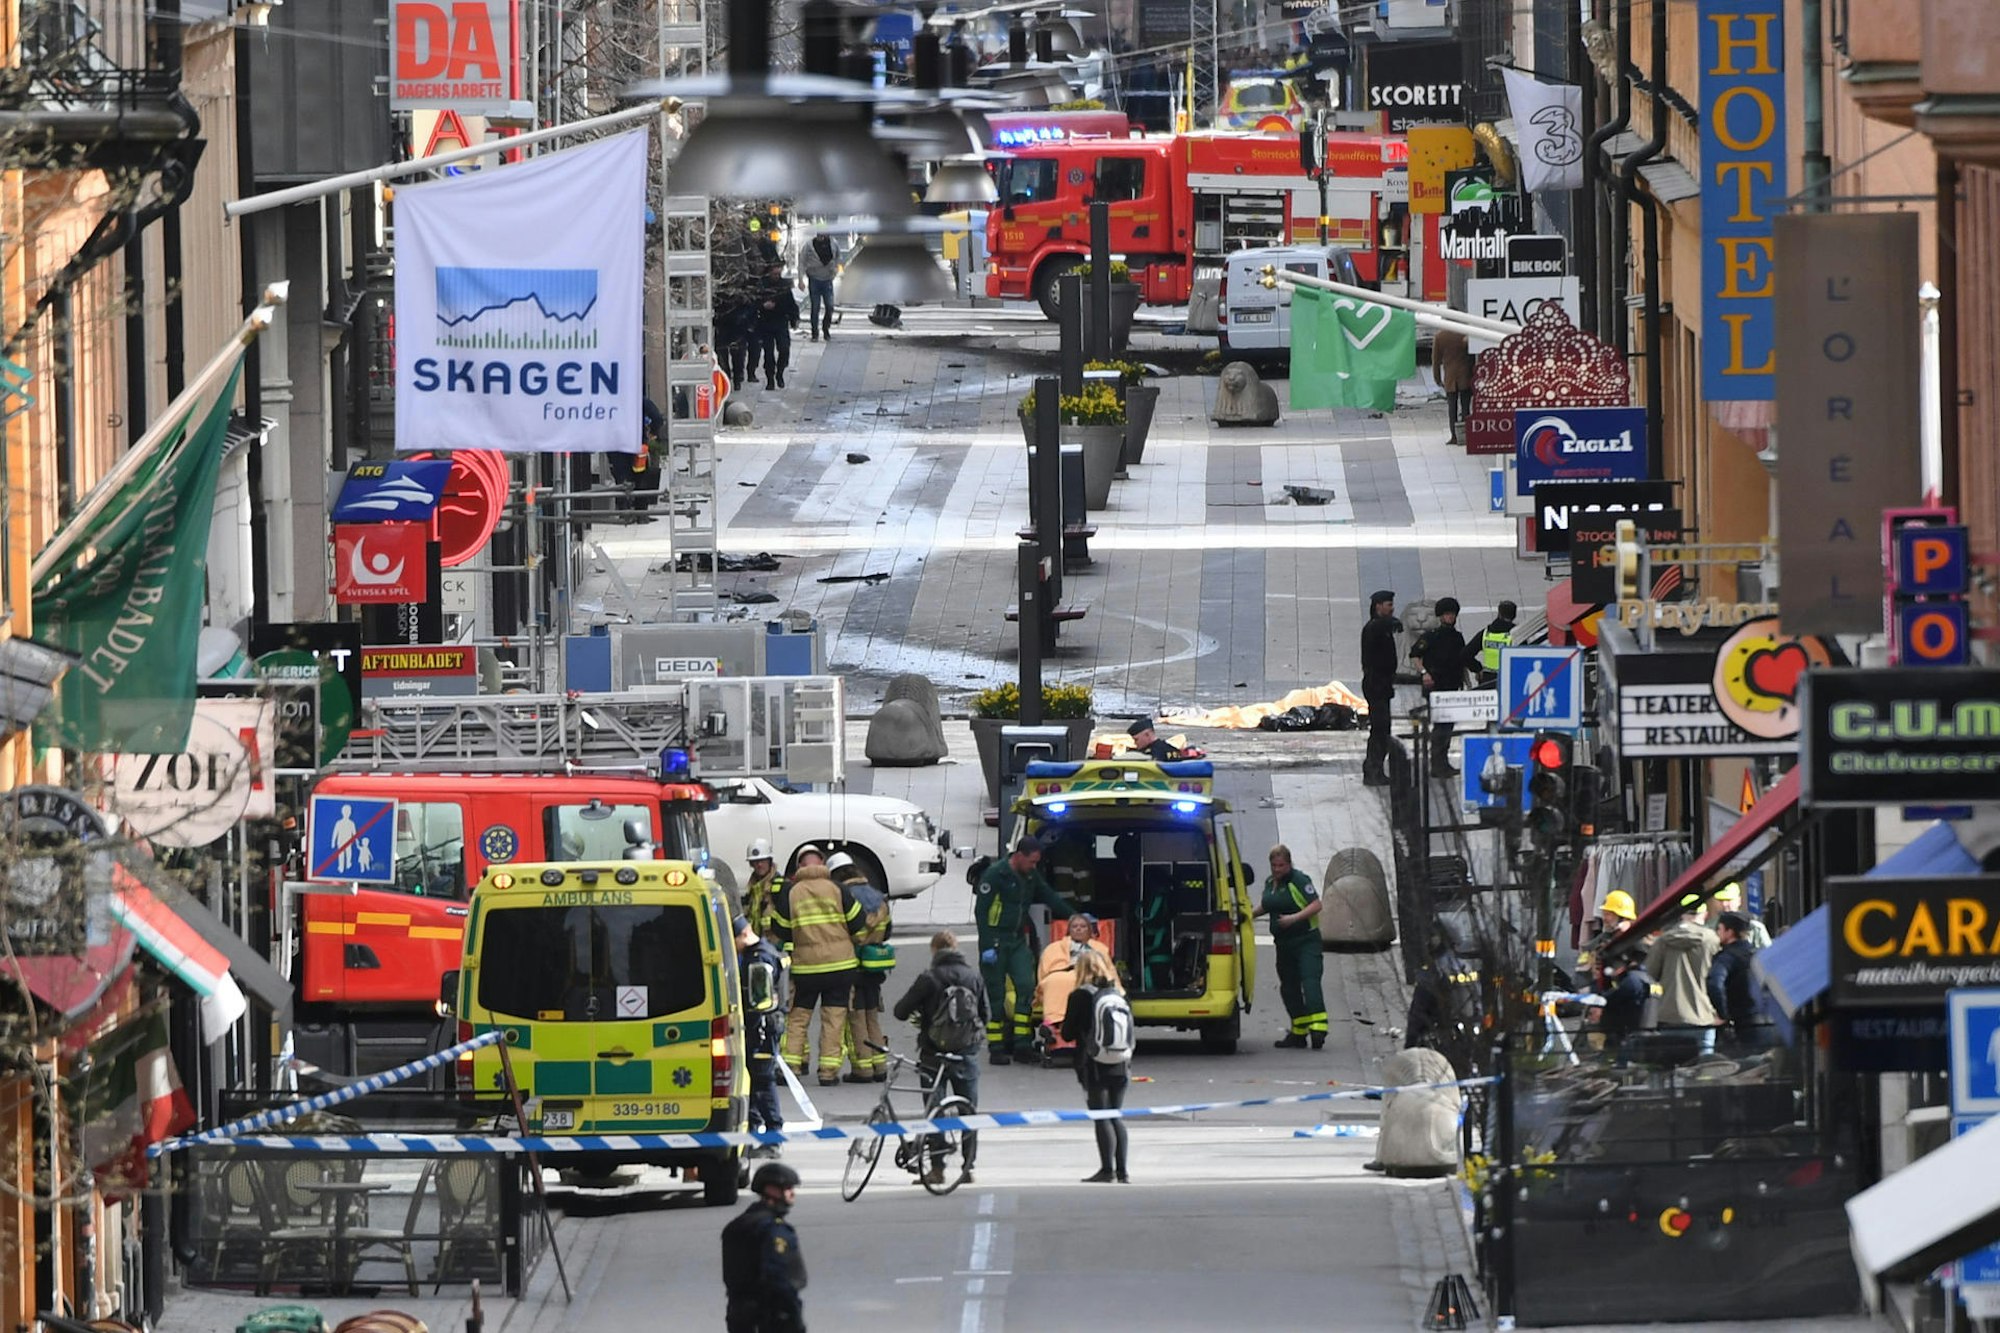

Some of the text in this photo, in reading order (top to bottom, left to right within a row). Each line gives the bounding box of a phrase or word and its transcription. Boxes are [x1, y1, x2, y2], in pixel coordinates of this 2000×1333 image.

[396, 2, 502, 80] DA
[397, 83, 502, 99] DAGENS ARBETE
[1371, 85, 1462, 106] SCORETT
[1707, 13, 1778, 376] HOTEL
[1512, 260, 1562, 273] BIK BOK
[413, 358, 619, 396] SKAGEN
[543, 402, 618, 420] fonder
[1471, 418, 1515, 433] DRO
[1562, 430, 1633, 453] EAGLE1
[354, 465, 384, 477] ATG
[347, 588, 411, 597] SVENSKA SPEL
[362, 653, 464, 670] AFTONBLADET
[542, 891, 633, 904] AMBULANS
[1843, 899, 2000, 959] CAR
[613, 1104, 679, 1116] 339-9180
